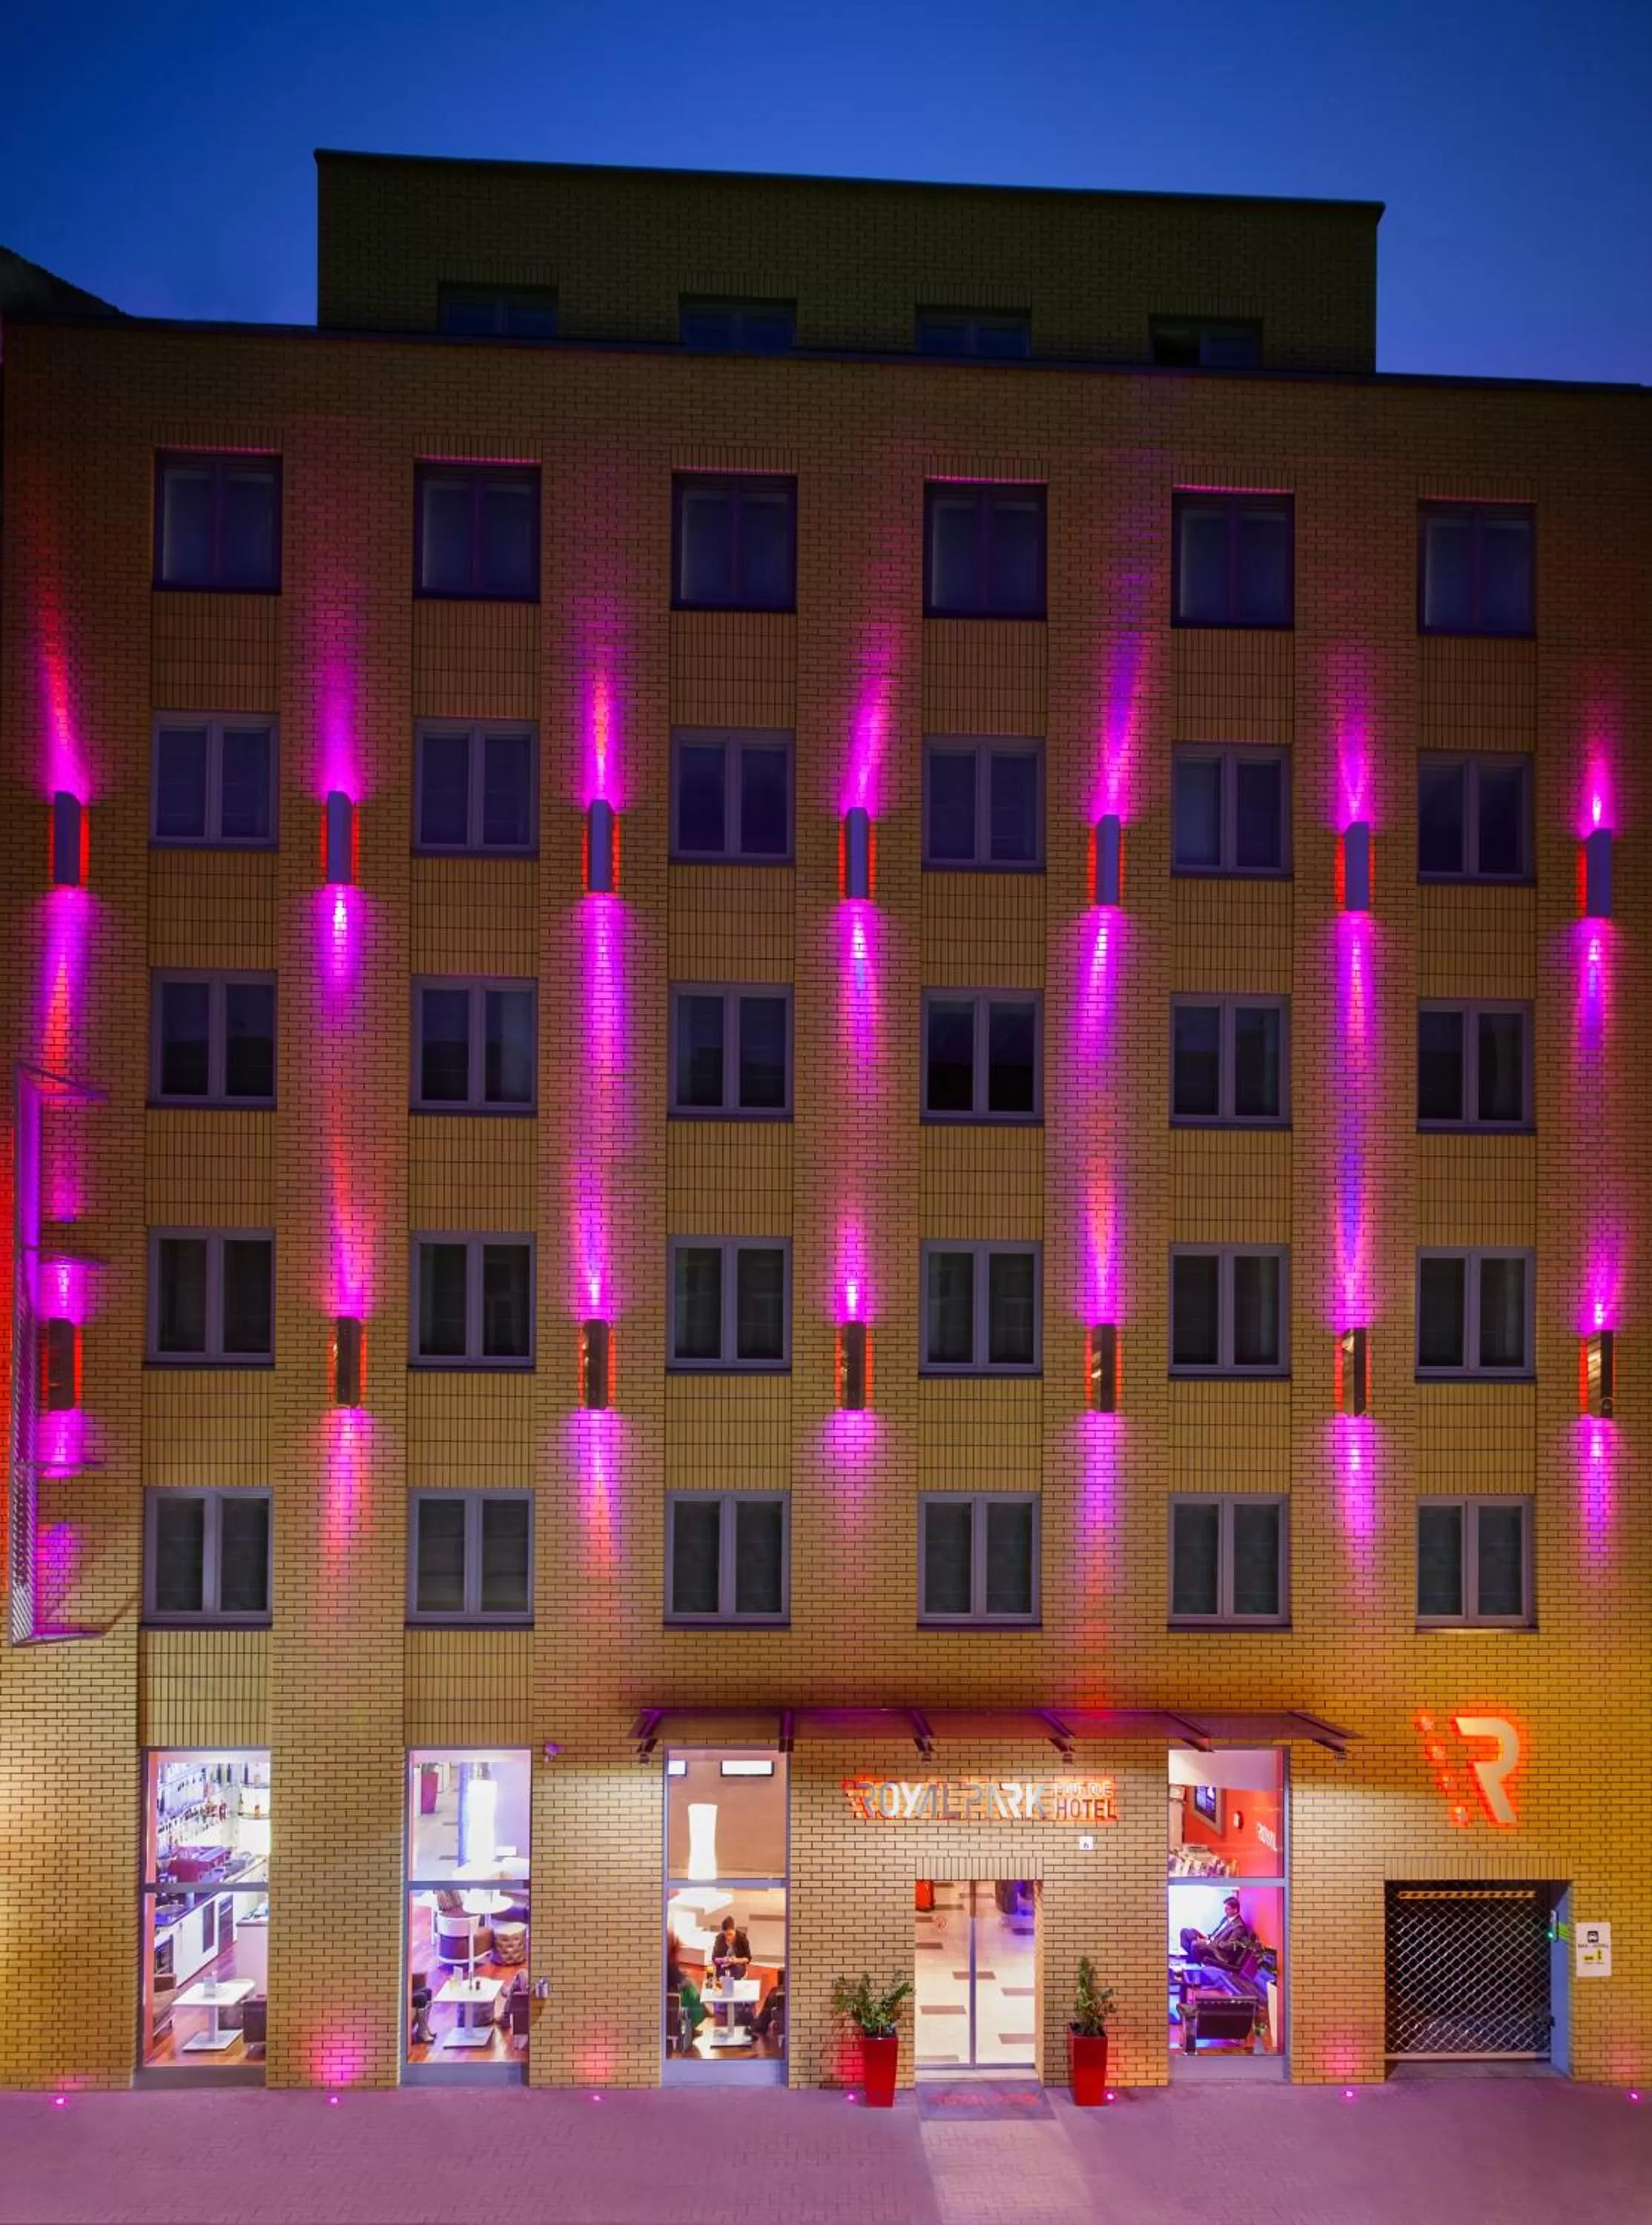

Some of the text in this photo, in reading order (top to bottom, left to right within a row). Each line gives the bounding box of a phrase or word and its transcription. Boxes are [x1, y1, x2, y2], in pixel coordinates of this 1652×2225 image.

[1456, 1716, 1519, 1824] R
[855, 1781, 1045, 1819] ROYAL PARK
[1057, 1798, 1117, 1819] HOTEL
